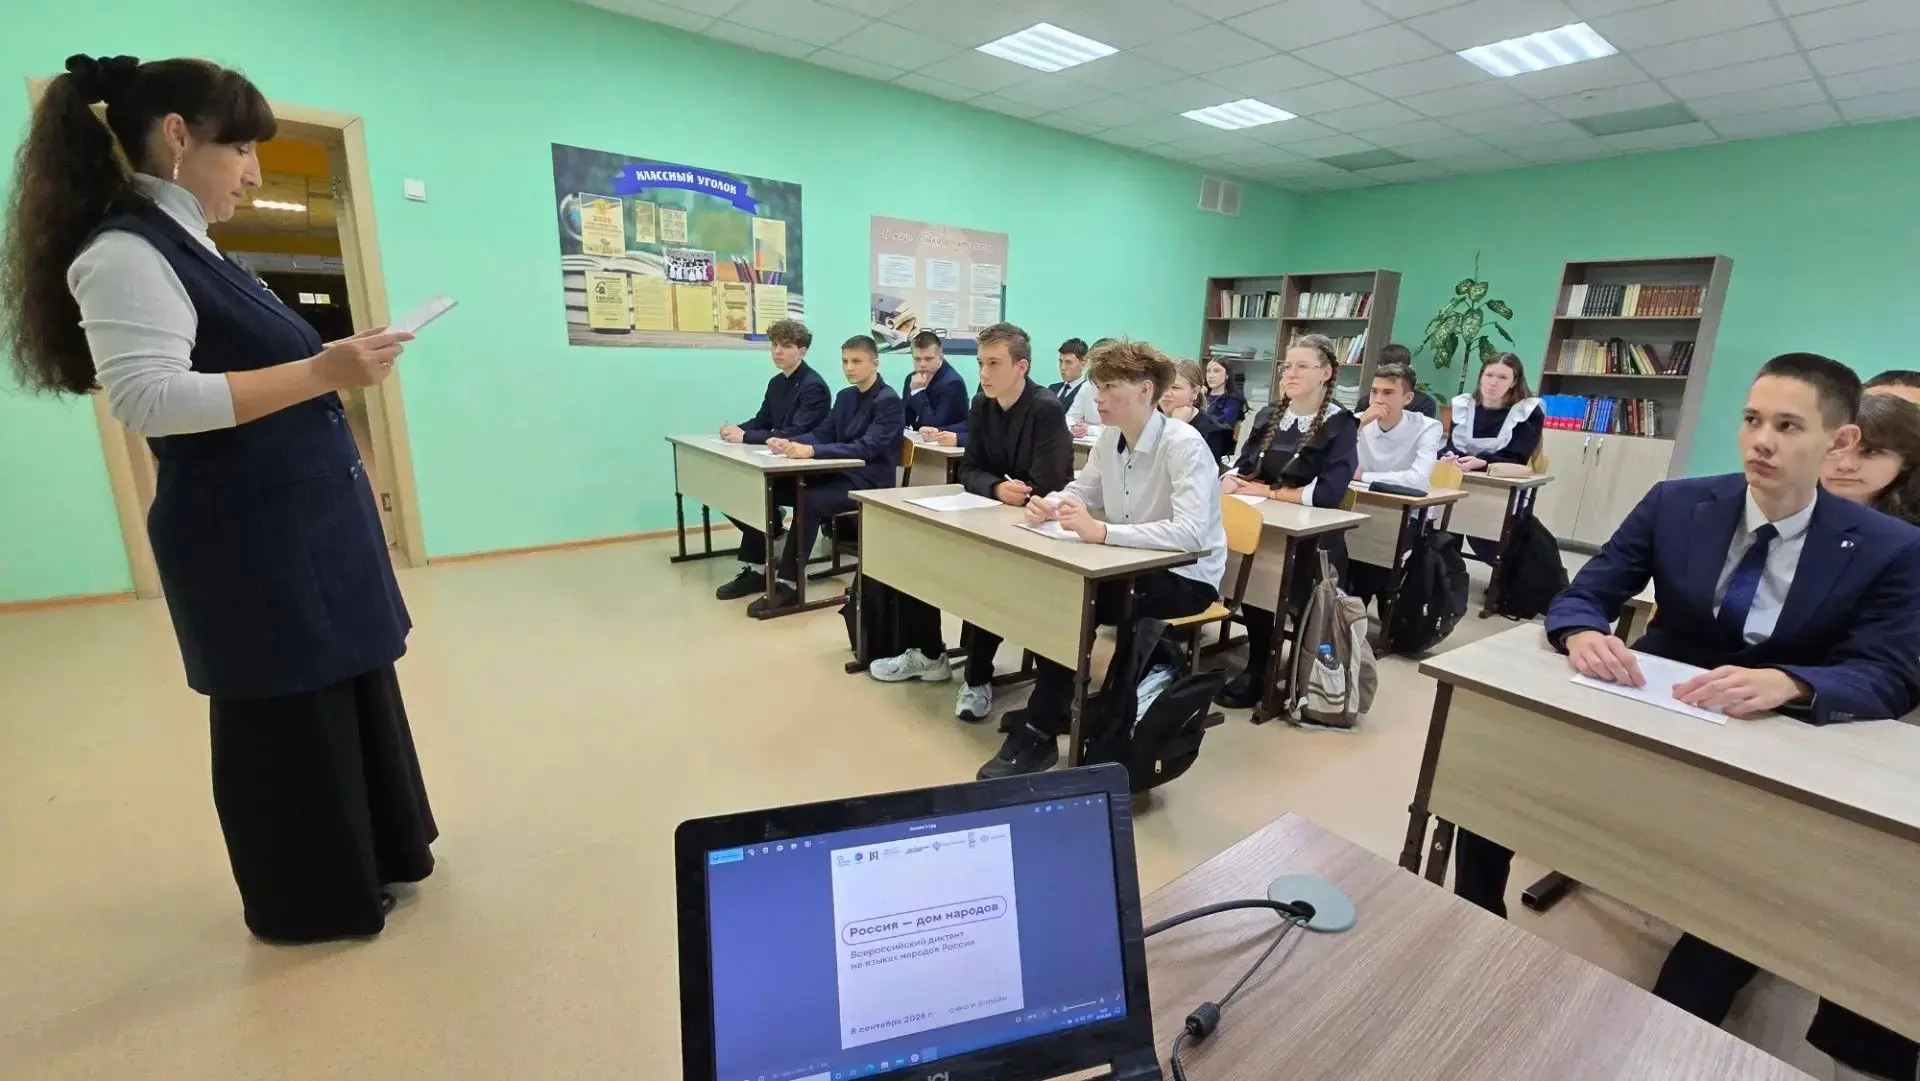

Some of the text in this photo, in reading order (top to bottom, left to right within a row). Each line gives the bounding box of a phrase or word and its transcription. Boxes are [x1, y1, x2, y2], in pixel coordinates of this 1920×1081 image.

[636, 170, 737, 195] КЛАССНЫЙ УГОЛОК
[850, 921, 899, 938] Россия
[916, 913, 942, 927] дом
[945, 903, 999, 920] народов
[850, 931, 965, 959] Всероссийский диктант
[850, 939, 975, 970] на языках народов России
[859, 1019, 902, 1034] сентября
